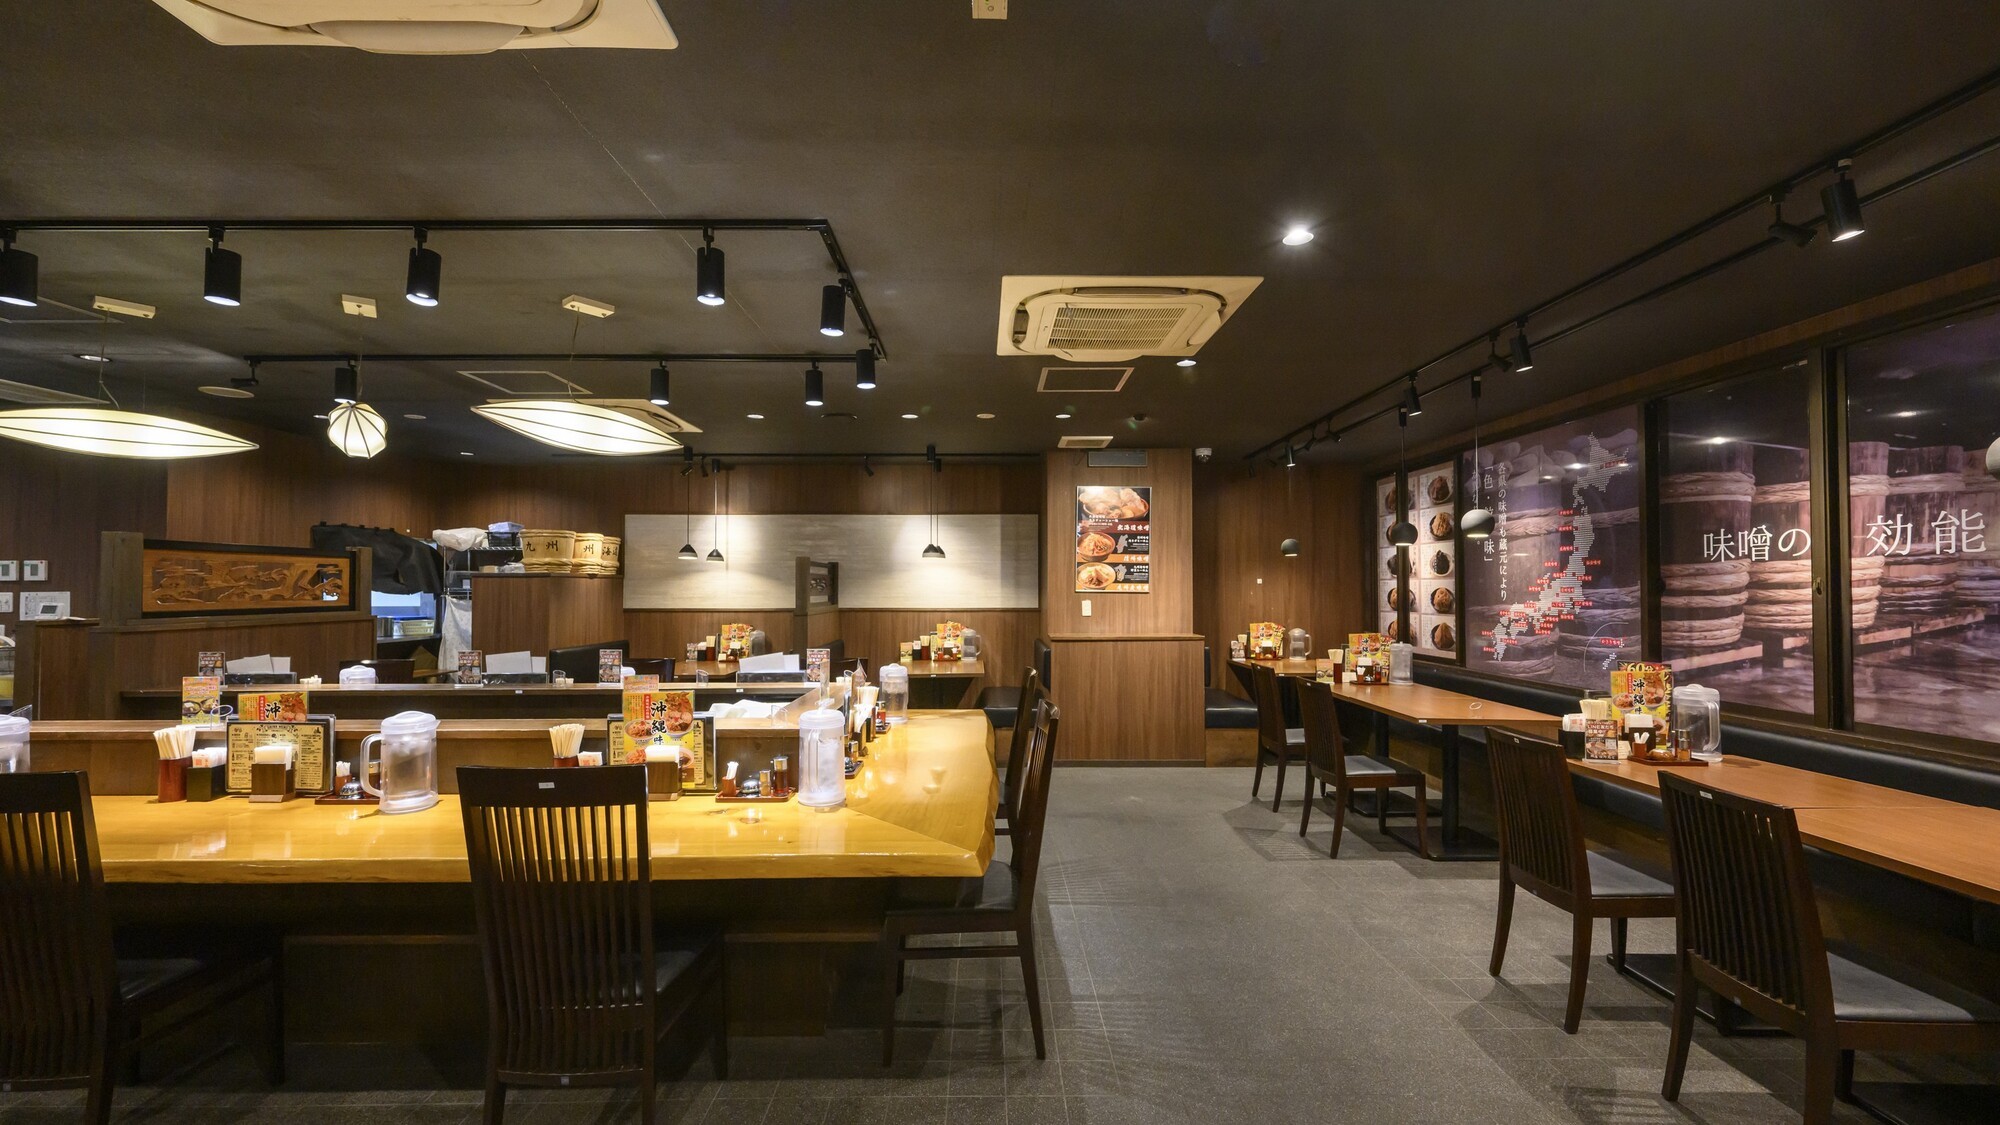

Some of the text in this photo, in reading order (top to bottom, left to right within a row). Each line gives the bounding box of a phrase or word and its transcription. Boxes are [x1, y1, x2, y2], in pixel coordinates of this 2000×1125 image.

[1498, 462, 1508, 601] 各県の味噌も蔵元により
[526, 540, 559, 552] 九州
[265, 702, 281, 718] 沖
